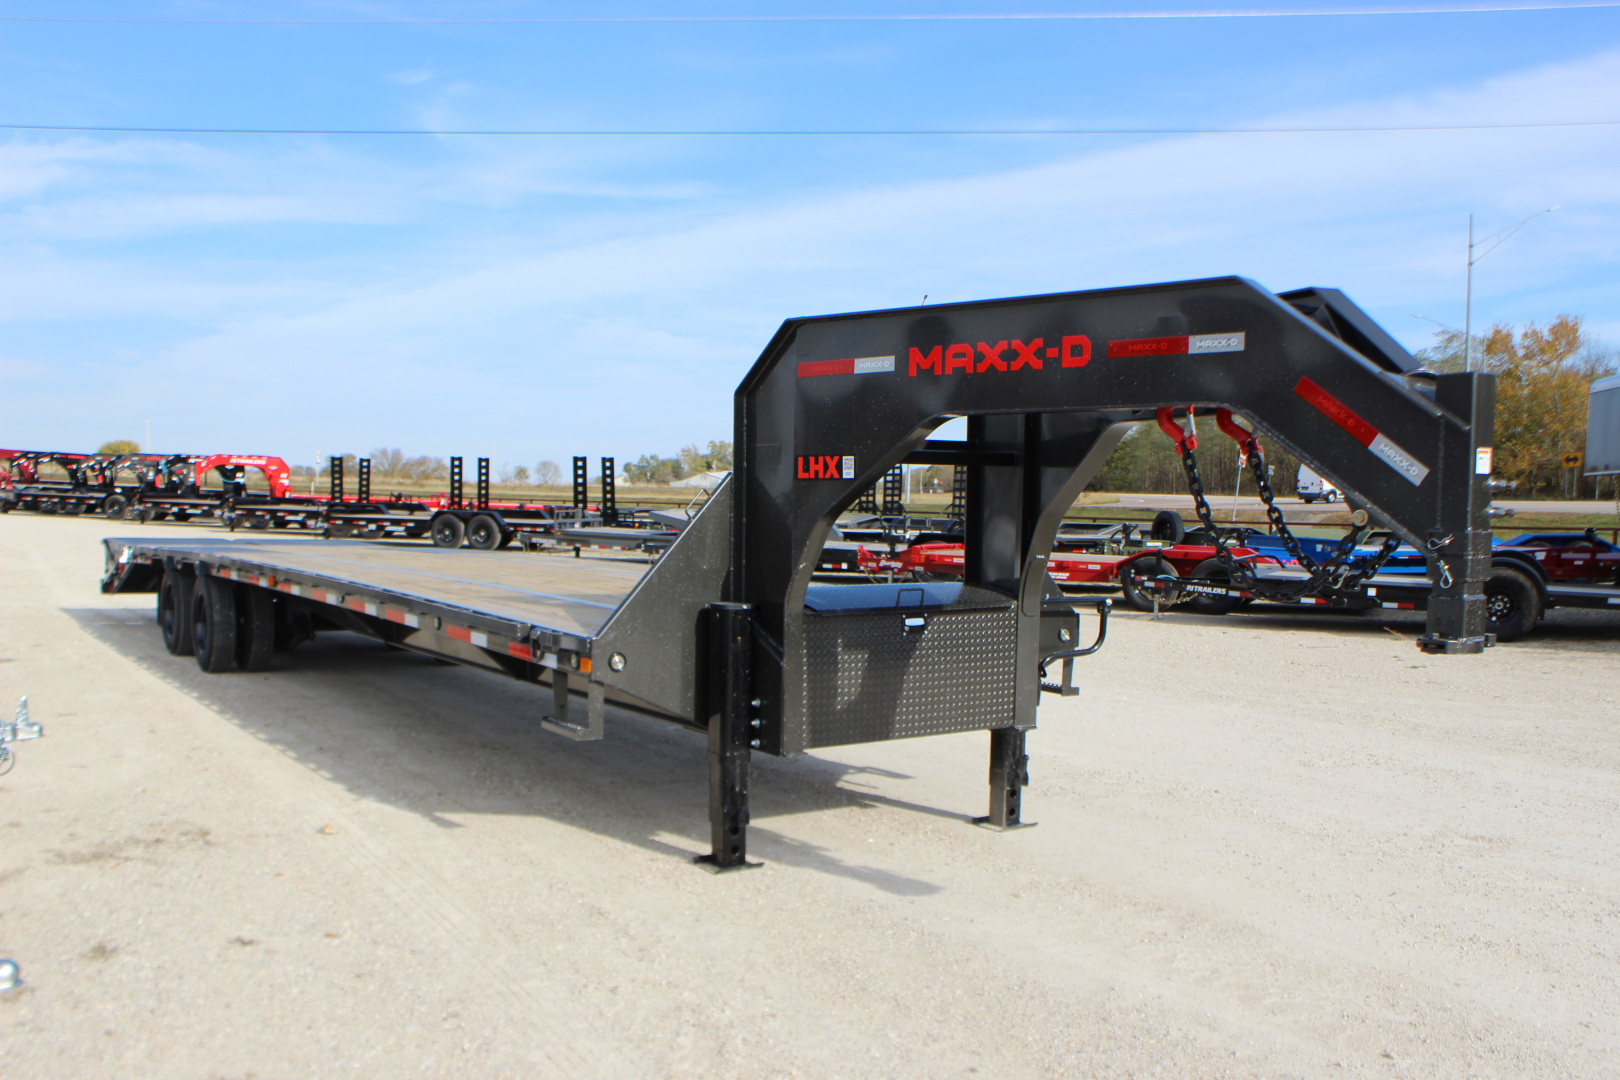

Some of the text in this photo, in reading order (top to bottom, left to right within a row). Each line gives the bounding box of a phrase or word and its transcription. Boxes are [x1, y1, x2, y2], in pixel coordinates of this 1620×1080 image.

[1196, 338, 1238, 349] MAXX-D
[859, 360, 890, 369] MAXX-D
[908, 335, 1092, 377] MAXX-D
[797, 455, 840, 479] LHX
[1378, 442, 1418, 477] MAXX-D
